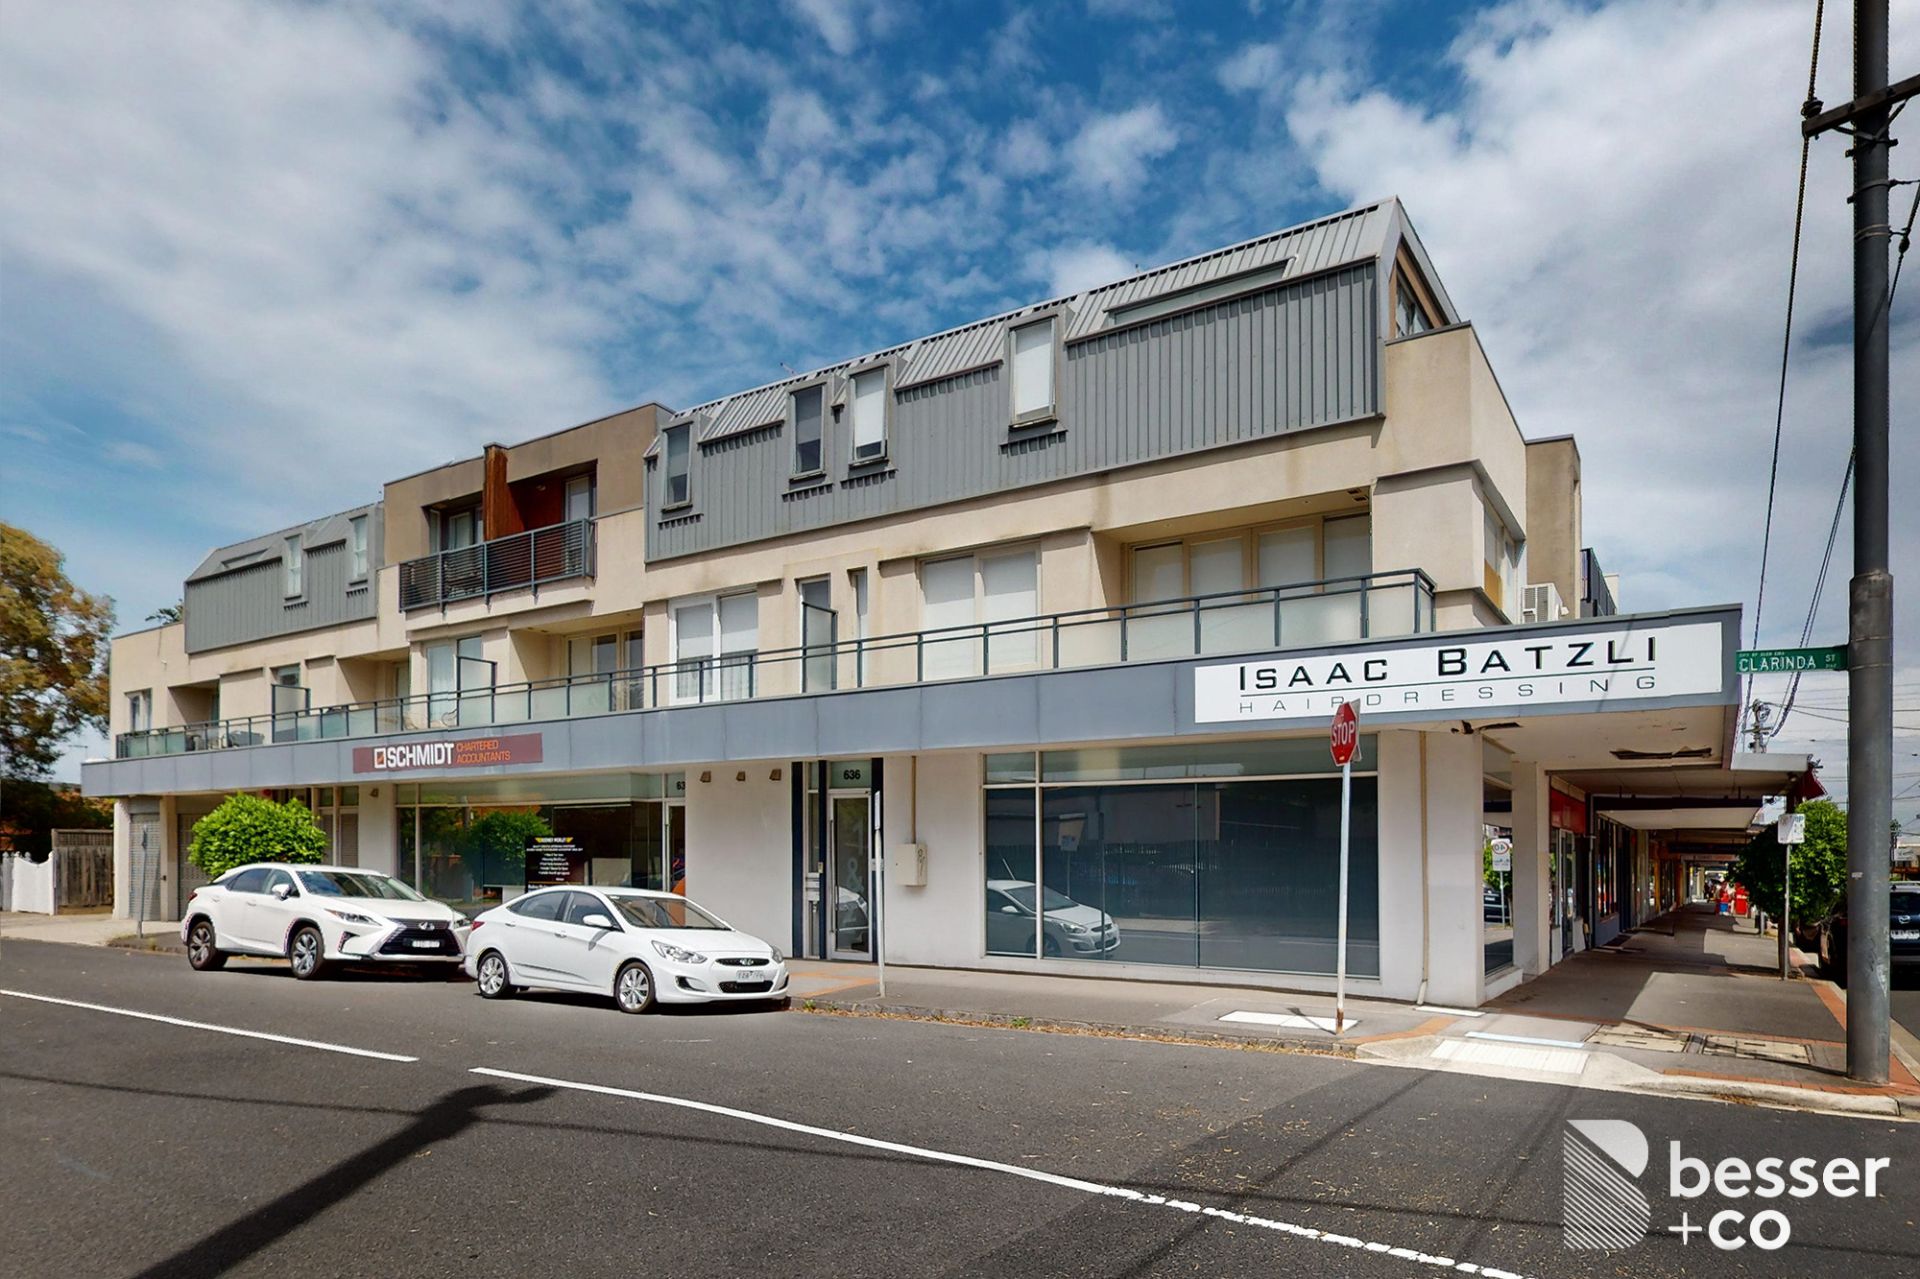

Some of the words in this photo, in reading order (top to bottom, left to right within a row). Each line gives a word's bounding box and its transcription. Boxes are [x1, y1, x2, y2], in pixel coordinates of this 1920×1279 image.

[1240, 659, 1388, 691] ISAAC
[1438, 636, 1656, 677] BATZLI
[1739, 655, 1816, 671] CLARINDA
[1825, 654, 1836, 663] ST
[1240, 676, 1655, 713] HAIRDRESSING
[1332, 720, 1355, 747] STOP
[387, 743, 454, 767] SCHMIDT
[456, 739, 499, 752] CHARTERED
[456, 750, 511, 764] ACCOUNTANTS
[843, 769, 861, 780] 636
